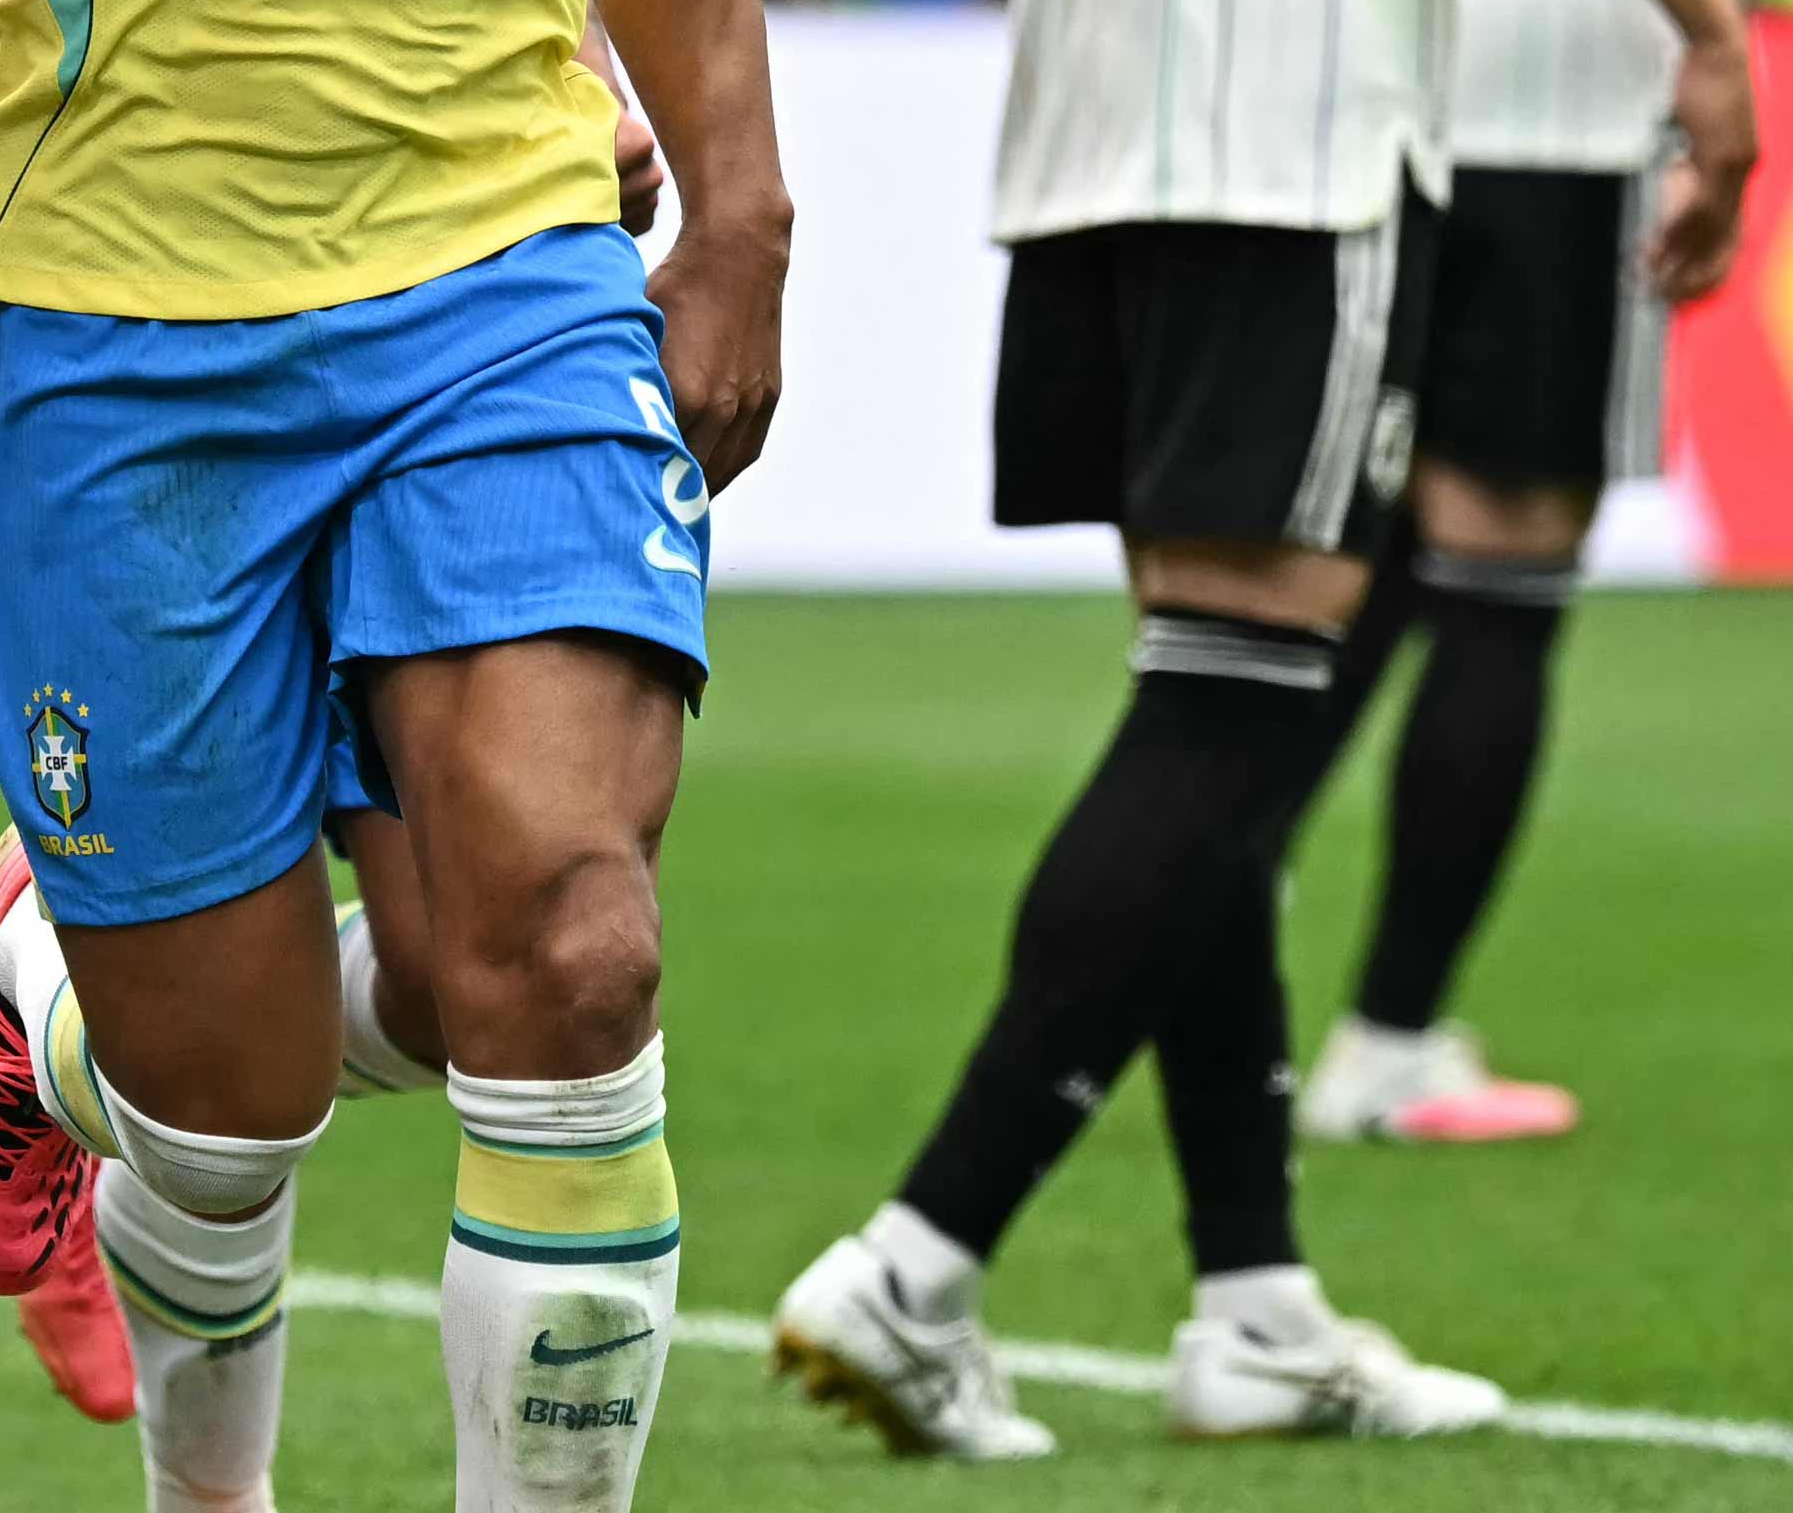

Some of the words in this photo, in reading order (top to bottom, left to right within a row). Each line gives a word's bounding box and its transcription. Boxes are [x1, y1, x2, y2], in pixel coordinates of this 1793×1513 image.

[45, 756, 68, 771] CBF
[38, 832, 116, 857] BRASIL
[522, 1395, 638, 1432] BRASIL
